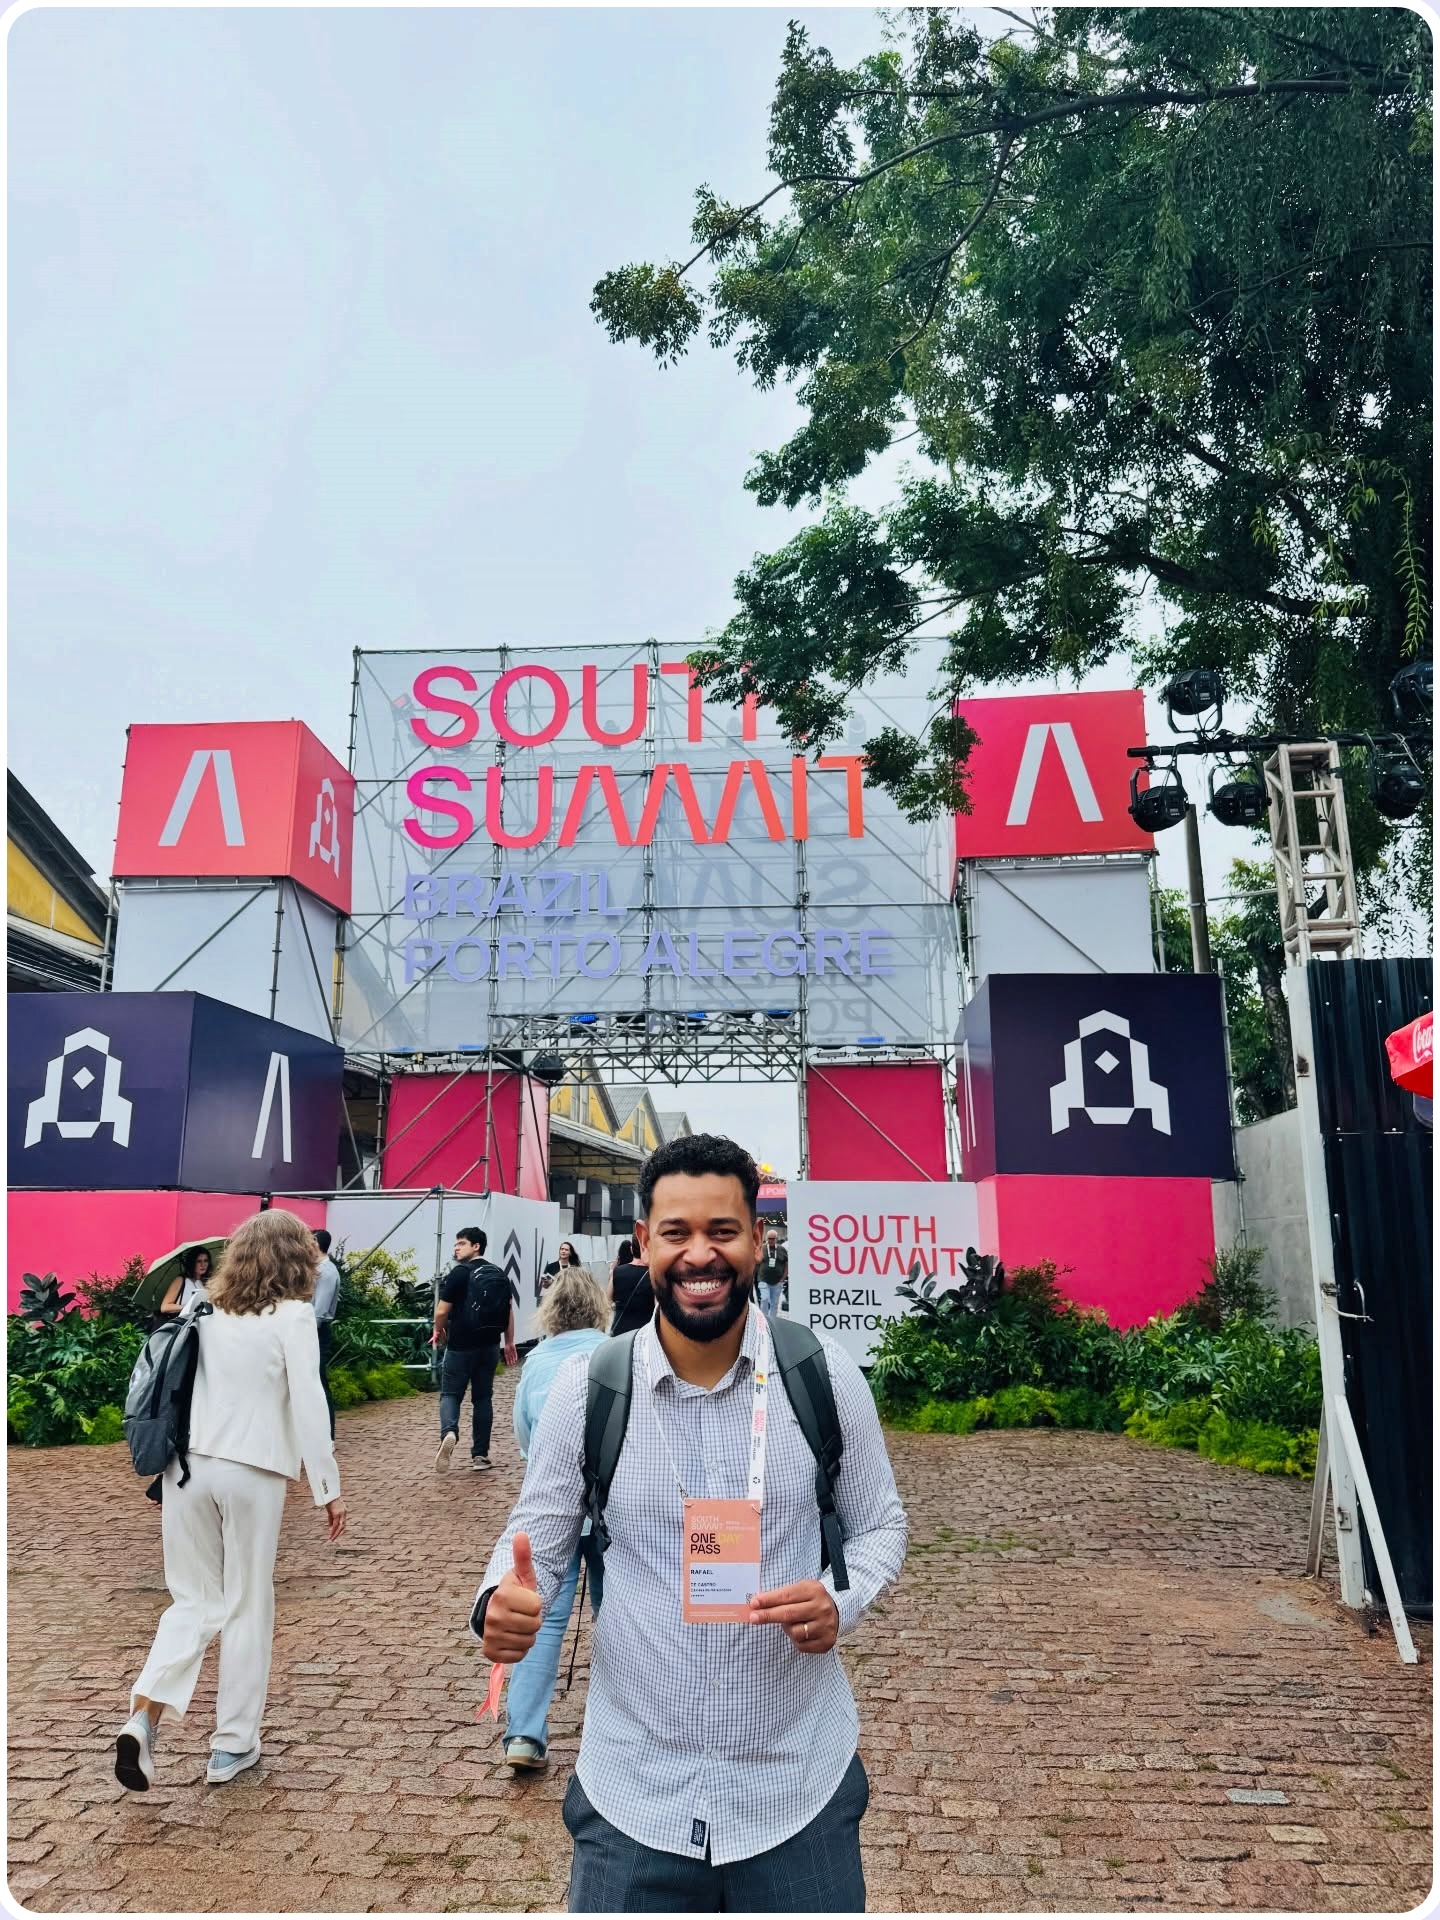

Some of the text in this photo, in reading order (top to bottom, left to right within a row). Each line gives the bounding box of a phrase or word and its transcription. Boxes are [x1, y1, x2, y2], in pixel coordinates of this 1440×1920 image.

[403, 755, 878, 849] SUMMIT
[403, 871, 627, 920] BRAZIL
[404, 932, 622, 984] PORTO
[638, 928, 895, 978] ALEGRE
[808, 1214, 937, 1244] SOUTH
[808, 1245, 963, 1276] SUMMIT
[809, 1289, 882, 1306] BRAZIL
[809, 1314, 879, 1331] PORTO
[690, 1532, 716, 1544] ONE
[690, 1544, 721, 1555] PASS
